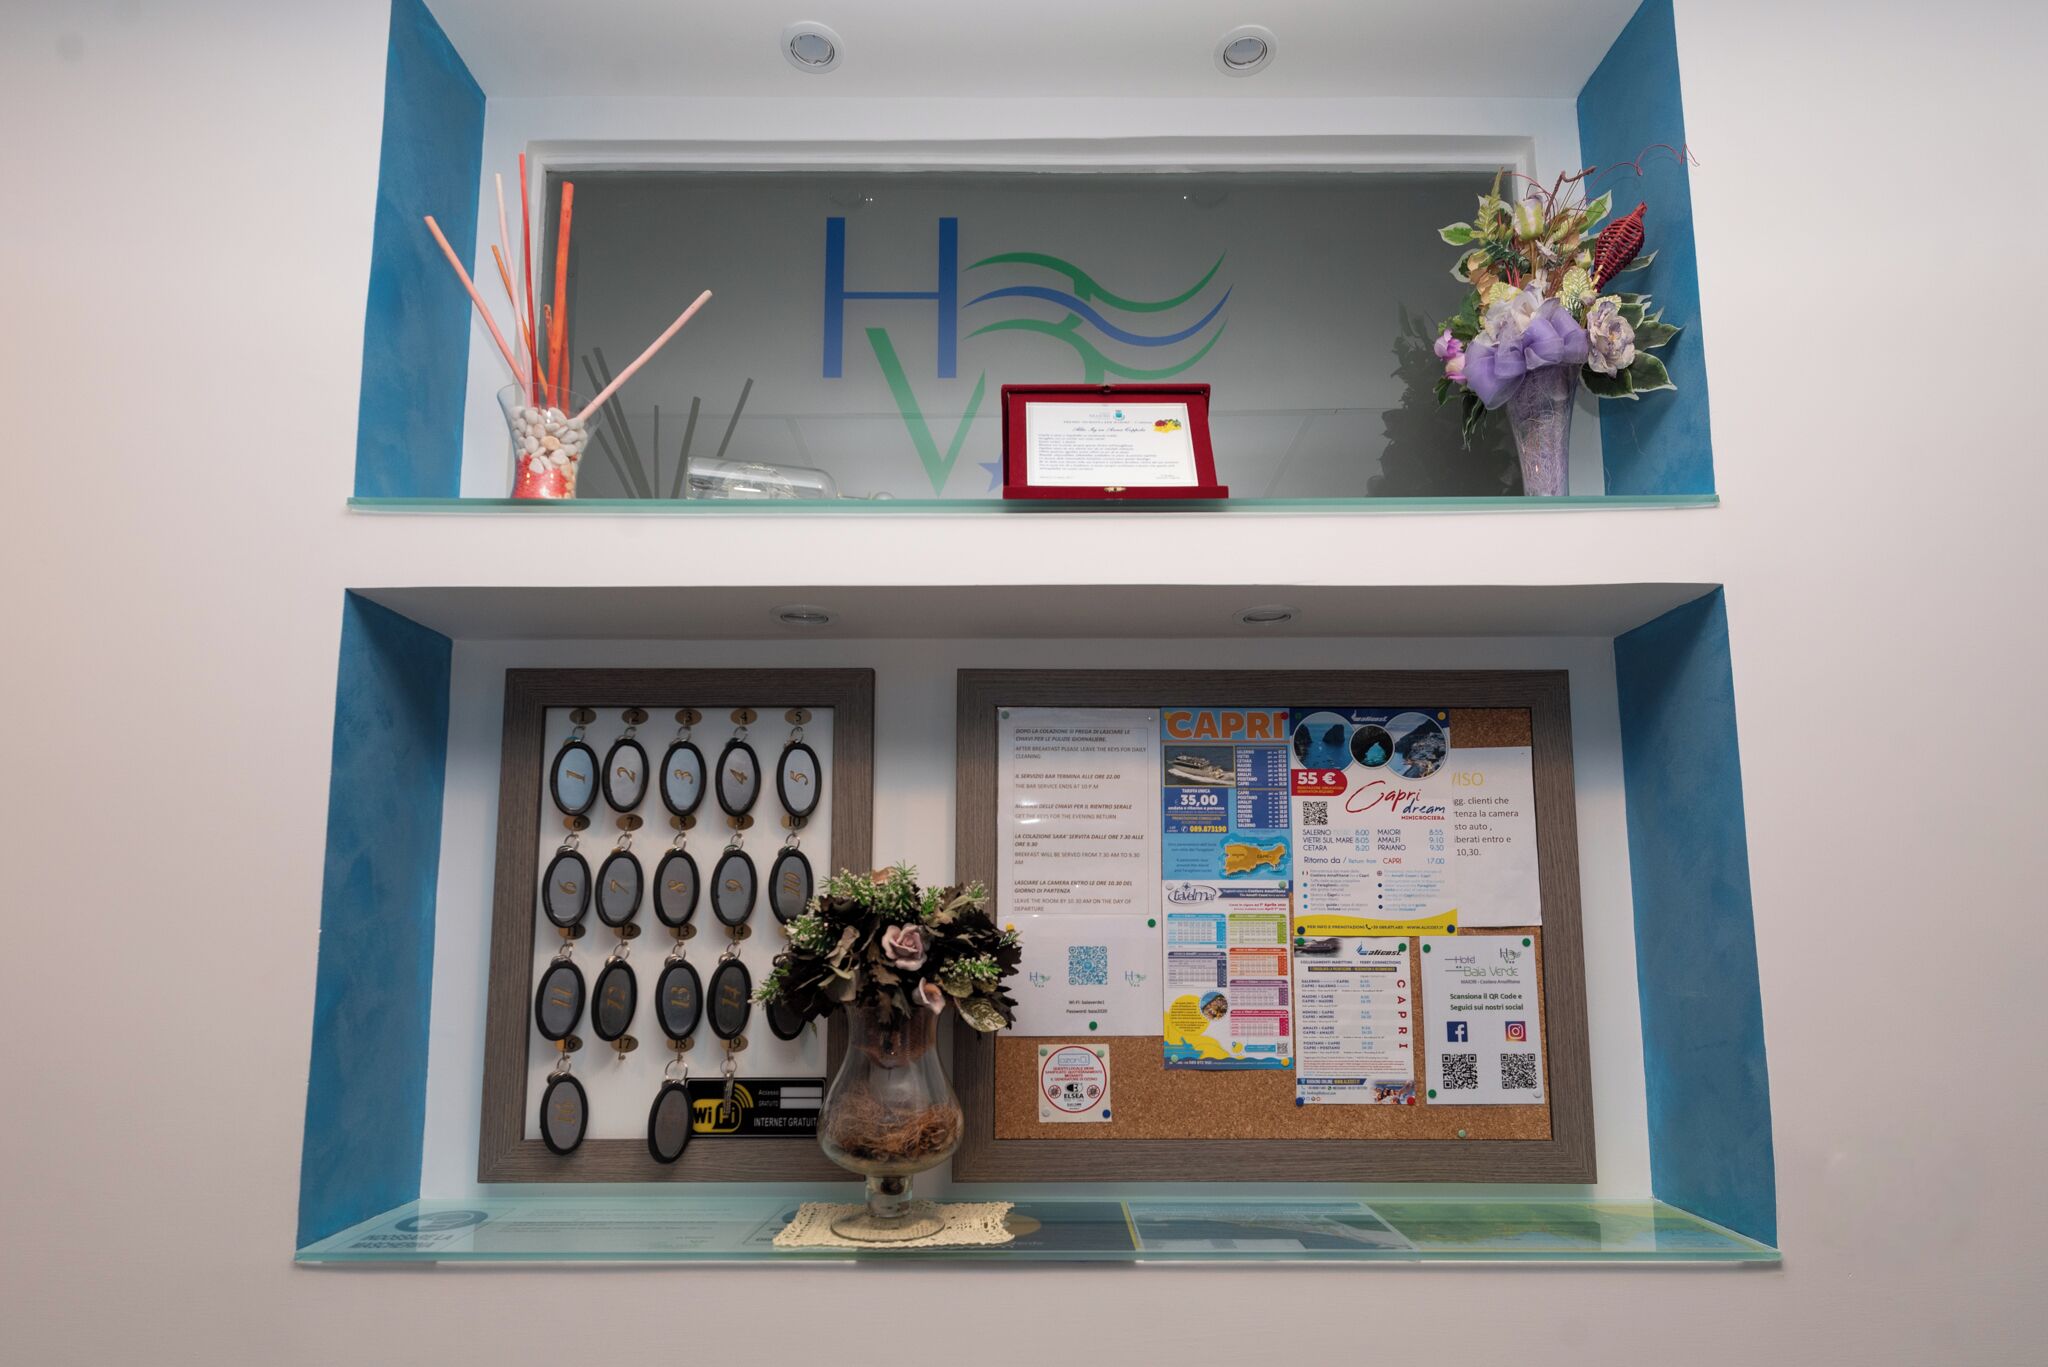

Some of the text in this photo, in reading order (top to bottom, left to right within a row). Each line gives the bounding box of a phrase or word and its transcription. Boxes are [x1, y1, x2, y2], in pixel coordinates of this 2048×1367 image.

[822, 217, 958, 378] H
[865, 328, 985, 496] V
[1166, 711, 1285, 740] CAPRI
[566, 770, 585, 784] 1
[617, 767, 636, 784] 2
[674, 769, 693, 784] 3
[730, 768, 748, 785] 4
[790, 770, 808, 786] 5
[1297, 772, 1336, 785] 55 €
[1180, 794, 1218, 806] 35,00
[1345, 780, 1421, 813] Capri
[1468, 797, 1493, 805] clienti
[1494, 797, 1509, 805] che
[1402, 798, 1445, 814] dream
[1479, 810, 1486, 818] la
[573, 817, 581, 828] 6
[626, 817, 633, 828] 7
[679, 816, 686, 828] 8
[737, 816, 744, 826] 9
[788, 816, 801, 827] 10
[1482, 836, 1504, 844] entro
[1456, 848, 1481, 857] 10,30.
[610, 879, 629, 895] 7
[667, 880, 688, 896] 8
[1464, 966, 1519, 977] Baia Verde
[1396, 979, 1408, 1048] CAPRI
[1450, 1004, 1473, 1012] Seguici
[563, 1038, 575, 1049] 16
[618, 1038, 630, 1049] 17
[675, 1039, 687, 1050] 18
[728, 1039, 741, 1049] 19
[754, 1117, 817, 1127] INTERNET GRATUIT
